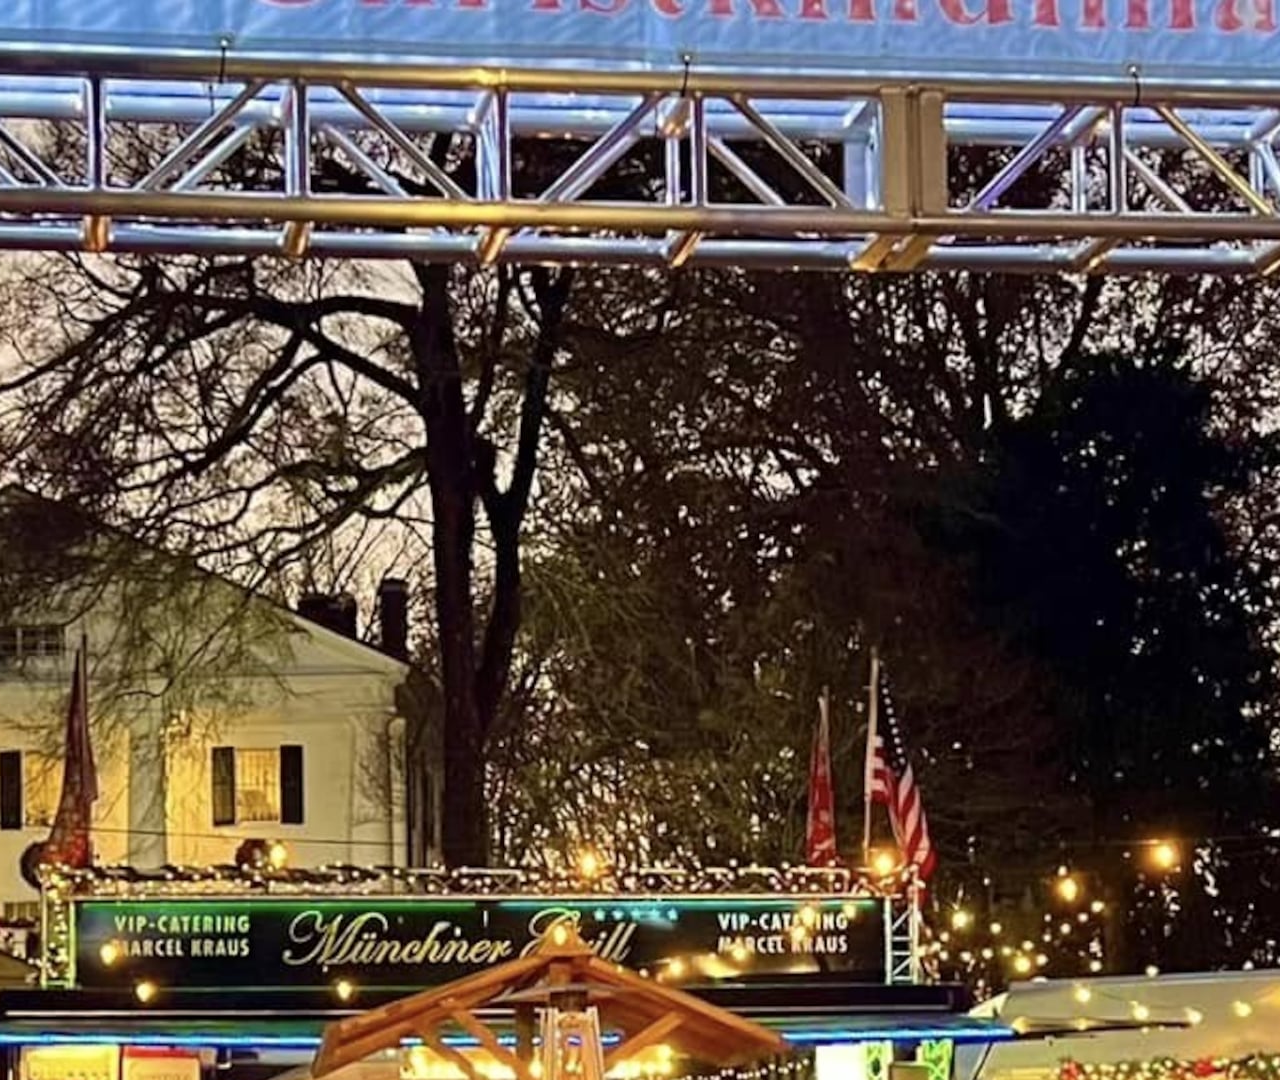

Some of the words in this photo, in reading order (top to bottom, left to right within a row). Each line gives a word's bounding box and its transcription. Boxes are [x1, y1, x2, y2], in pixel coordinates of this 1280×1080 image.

[114, 914, 251, 933] VIP-CATERING
[717, 911, 849, 931] VIP-CATEING
[281, 909, 512, 966] Münchner
[520, 906, 635, 963] Gill
[791, 935, 848, 953] KRAUS
[191, 938, 251, 957] KRAUS
